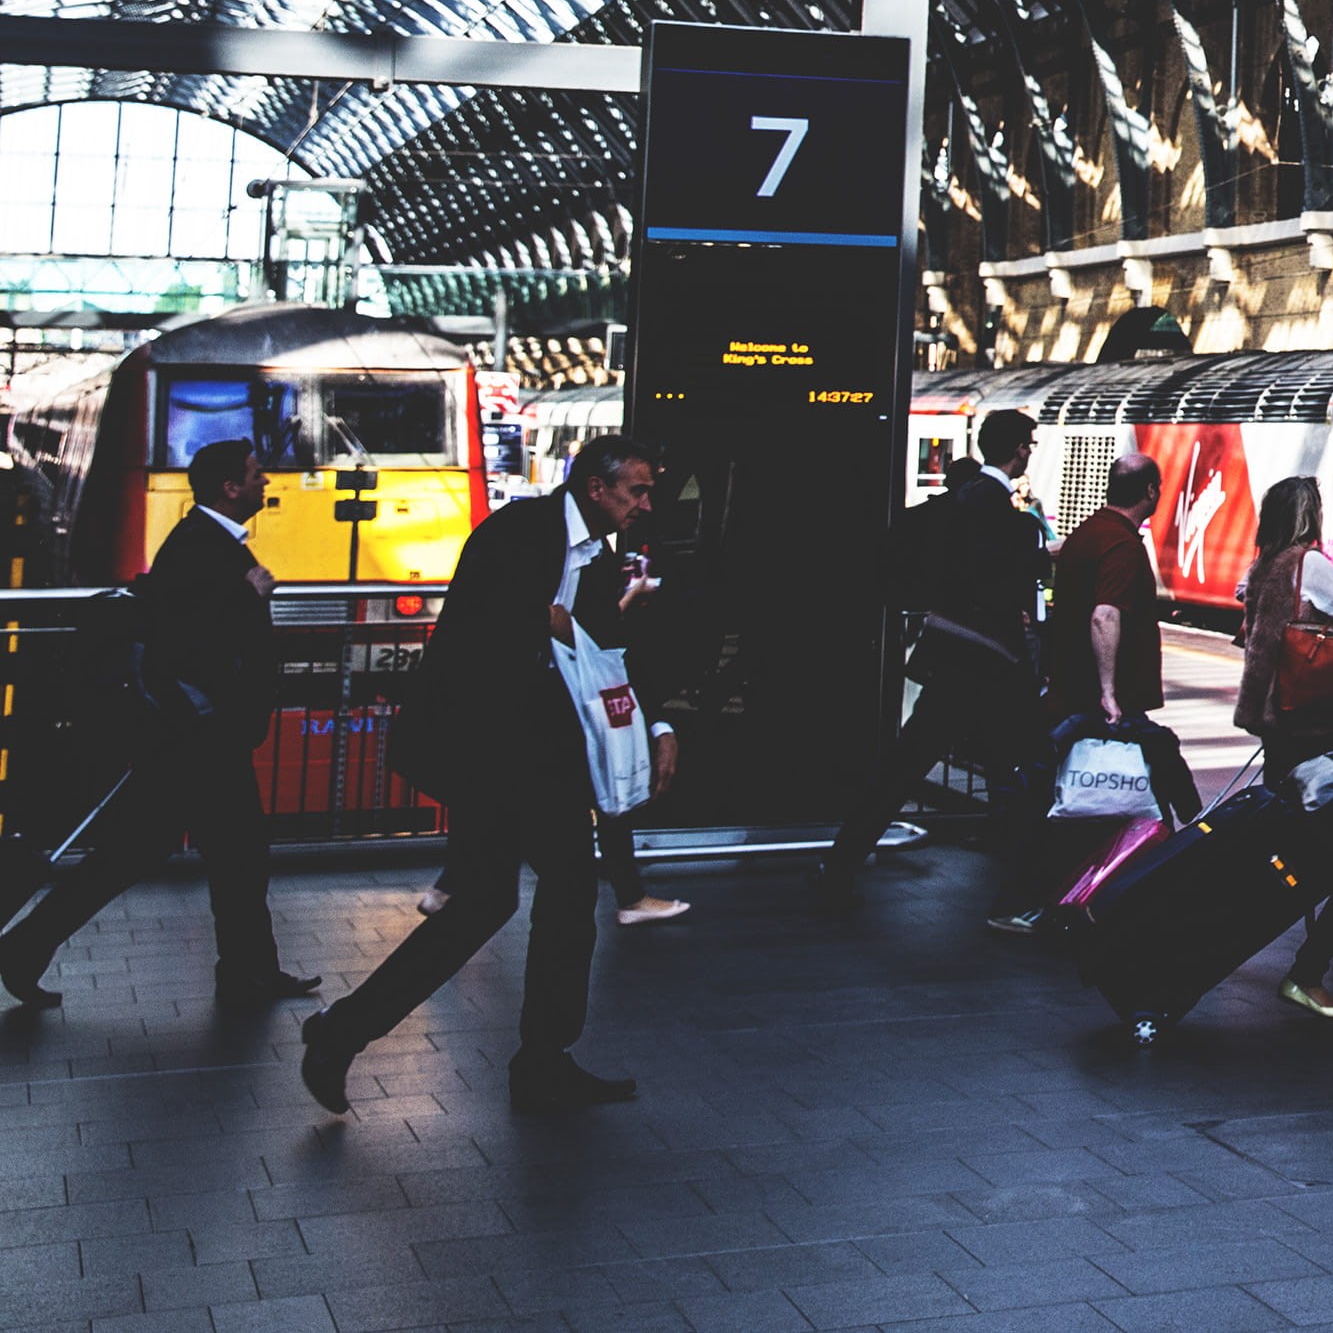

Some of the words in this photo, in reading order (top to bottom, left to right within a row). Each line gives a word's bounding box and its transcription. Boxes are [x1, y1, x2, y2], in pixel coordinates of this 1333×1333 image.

[751, 116, 809, 197] 7
[729, 341, 787, 353] Welcome
[791, 342, 809, 354] to
[722, 354, 768, 366] King's
[771, 355, 814, 366] Cross
